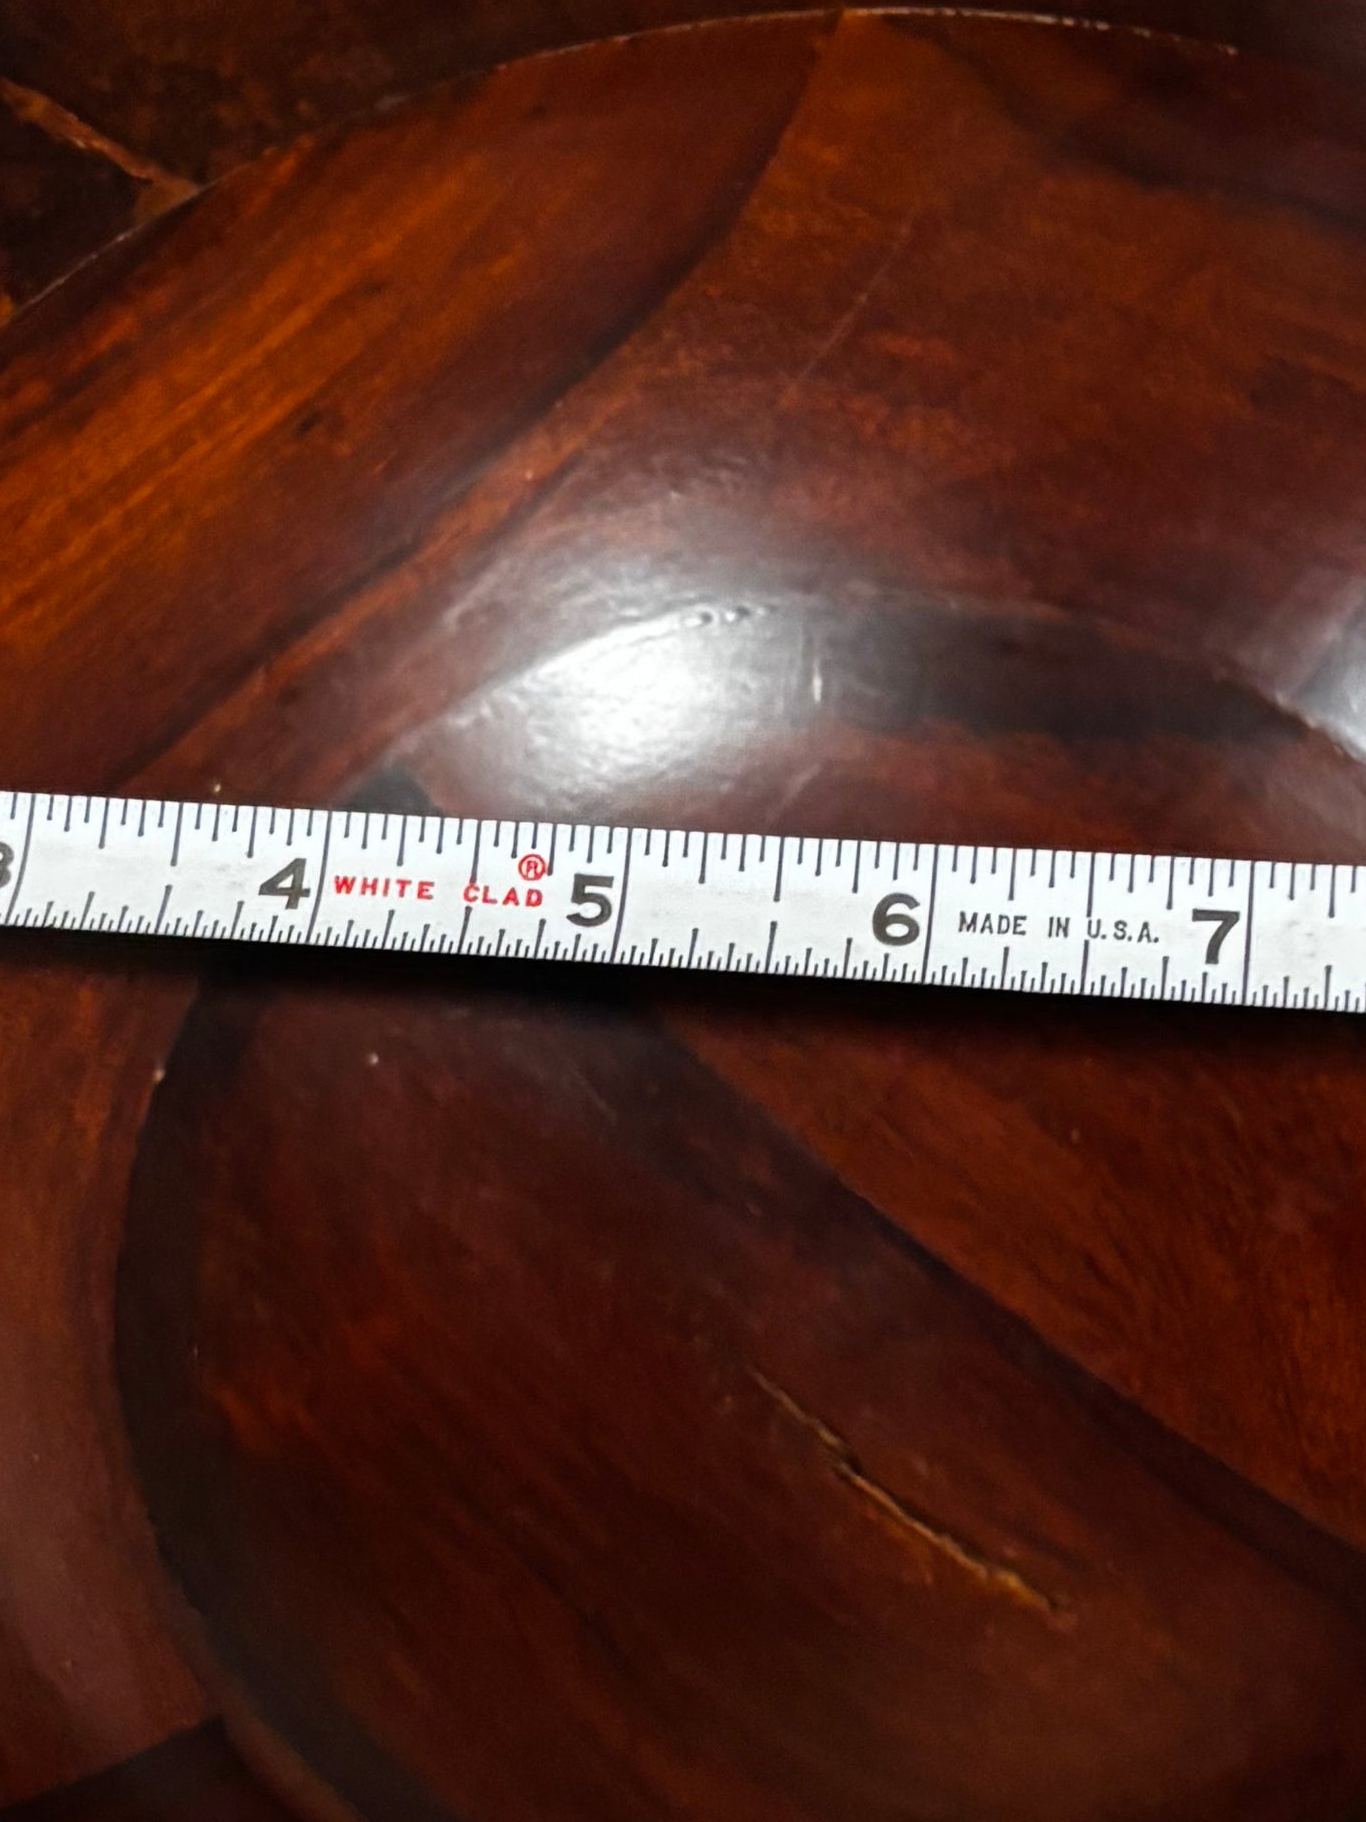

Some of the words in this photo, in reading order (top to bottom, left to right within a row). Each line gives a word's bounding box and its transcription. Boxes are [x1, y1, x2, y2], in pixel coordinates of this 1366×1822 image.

[258, 858, 311, 910] 4
[334, 875, 434, 900] WHITE
[462, 883, 543, 908] CLAD
[566, 873, 614, 927] 5
[872, 893, 920, 946] 6
[958, 911, 1027, 936] MADE
[1048, 917, 1070, 939] IN
[1086, 919, 1160, 944] U.S.A.
[1191, 908, 1240, 965] 7
